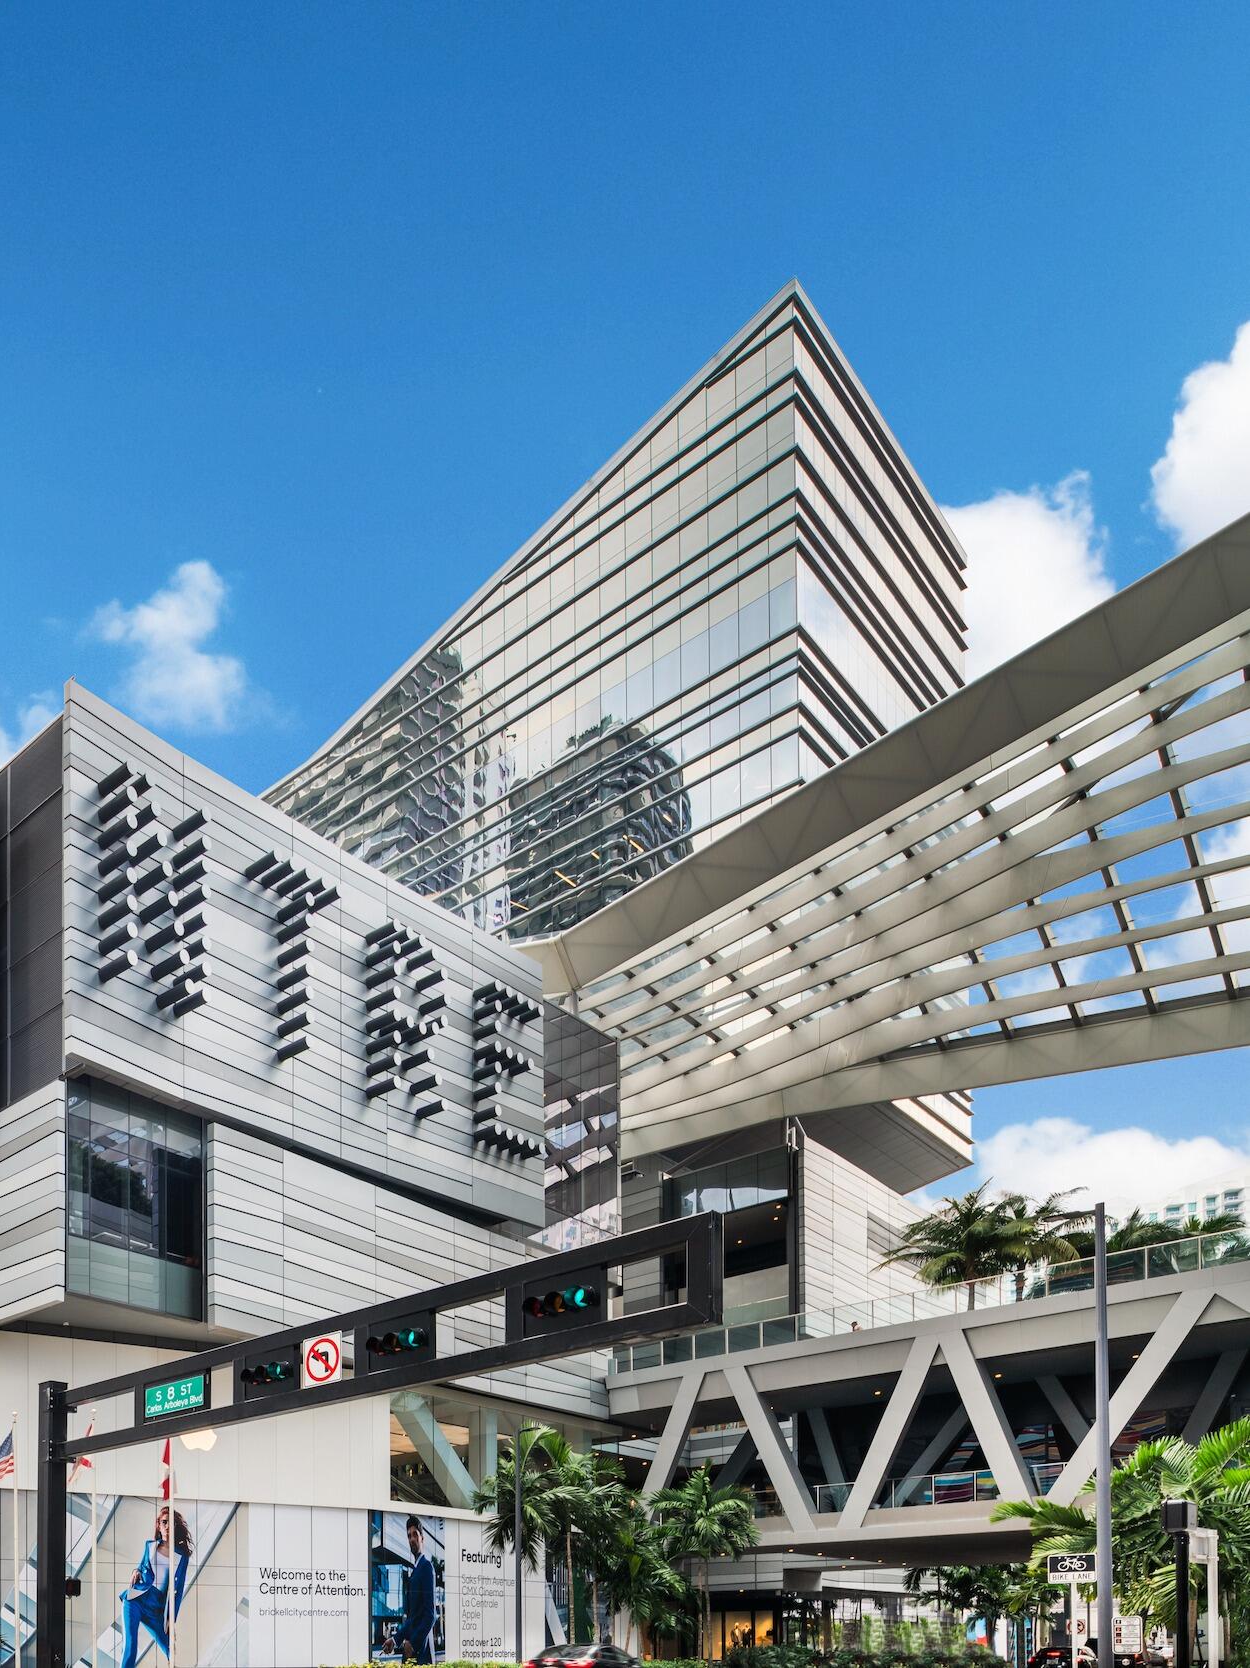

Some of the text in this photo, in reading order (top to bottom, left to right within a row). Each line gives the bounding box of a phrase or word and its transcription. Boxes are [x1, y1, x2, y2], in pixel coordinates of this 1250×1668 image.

[156, 1383, 192, 1402] S 8 ST
[190, 1393, 203, 1404] Blvd
[461, 1549, 502, 1568] Featuring
[259, 1567, 346, 1581] Welcome to the
[1052, 1573, 1068, 1581] BIKE
[259, 1582, 366, 1597] Centre of Attention.
[478, 1586, 504, 1597] Cinema
[461, 1597, 499, 1609] La Centrale
[259, 1607, 349, 1618] brickellcitycentre.com
[461, 1609, 481, 1621] Apple
[461, 1621, 477, 1631] Zara
[461, 1637, 502, 1647] and over 120
[461, 1649, 481, 1660] shops
[482, 1649, 494, 1659] and
